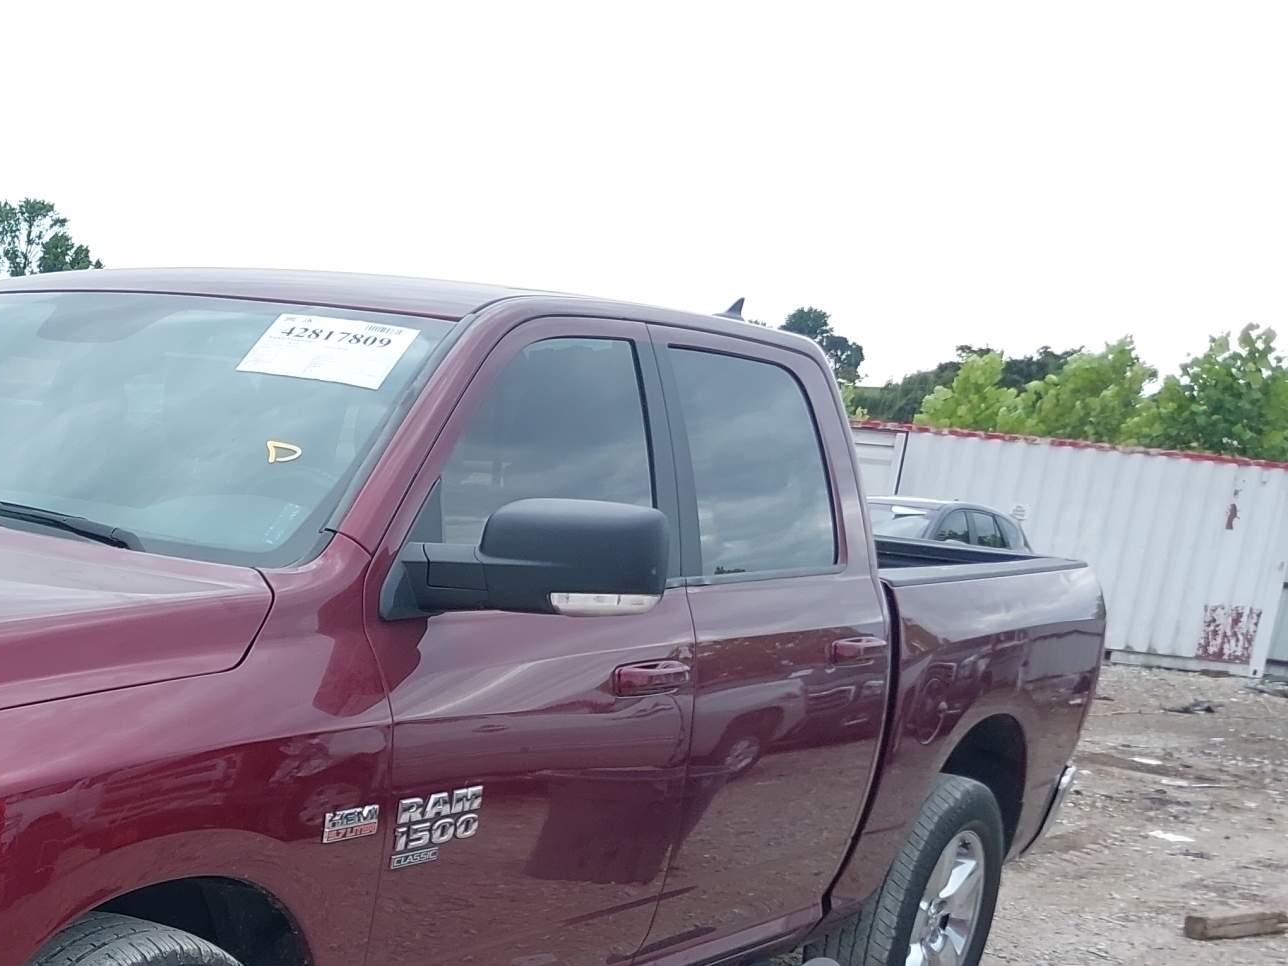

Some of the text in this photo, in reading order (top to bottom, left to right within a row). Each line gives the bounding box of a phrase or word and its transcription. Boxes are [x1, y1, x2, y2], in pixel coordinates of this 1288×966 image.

[281, 325, 392, 348] 42817809
[396, 785, 484, 825] RAM
[394, 813, 479, 851] 1500
[392, 848, 439, 868] CLASSIC
